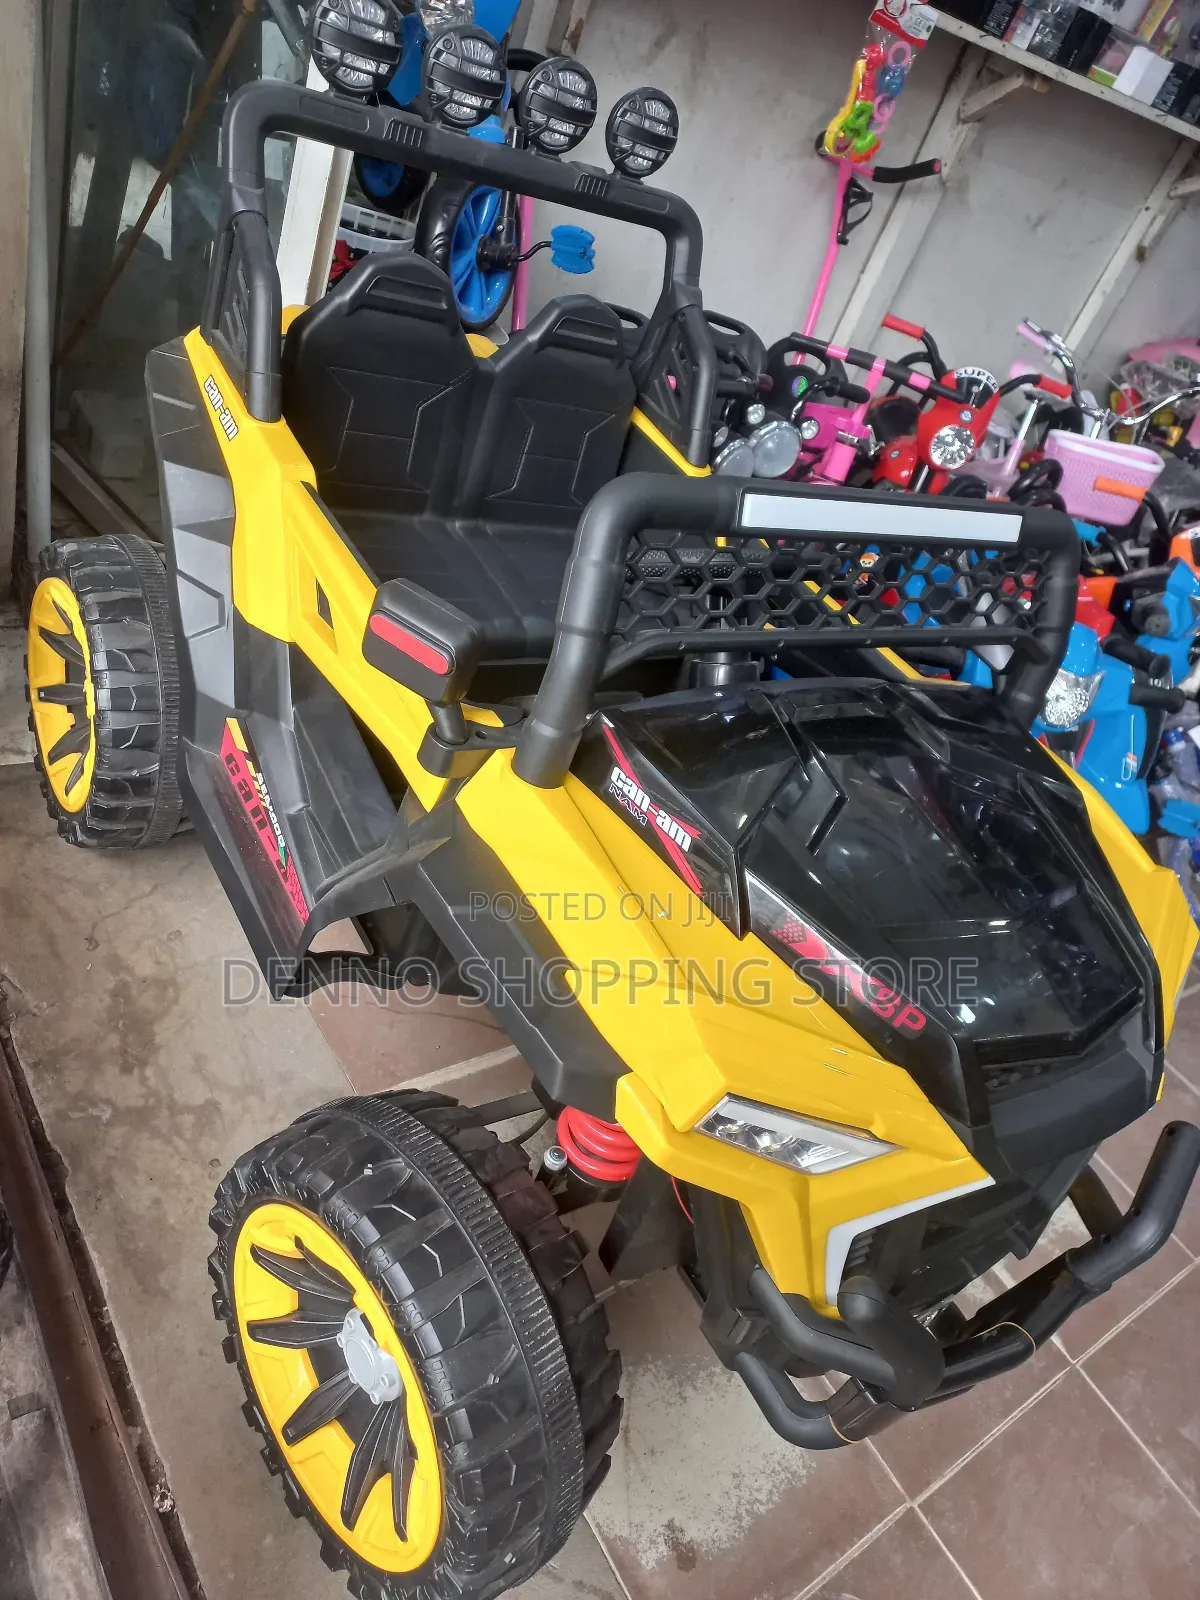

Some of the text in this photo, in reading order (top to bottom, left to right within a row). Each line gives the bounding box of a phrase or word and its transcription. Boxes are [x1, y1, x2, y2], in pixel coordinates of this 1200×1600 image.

[955, 368, 998, 391] SUPER
[203, 374, 239, 441] can-am
[608, 782, 648, 826] NAM
[610, 766, 692, 852] can-am
